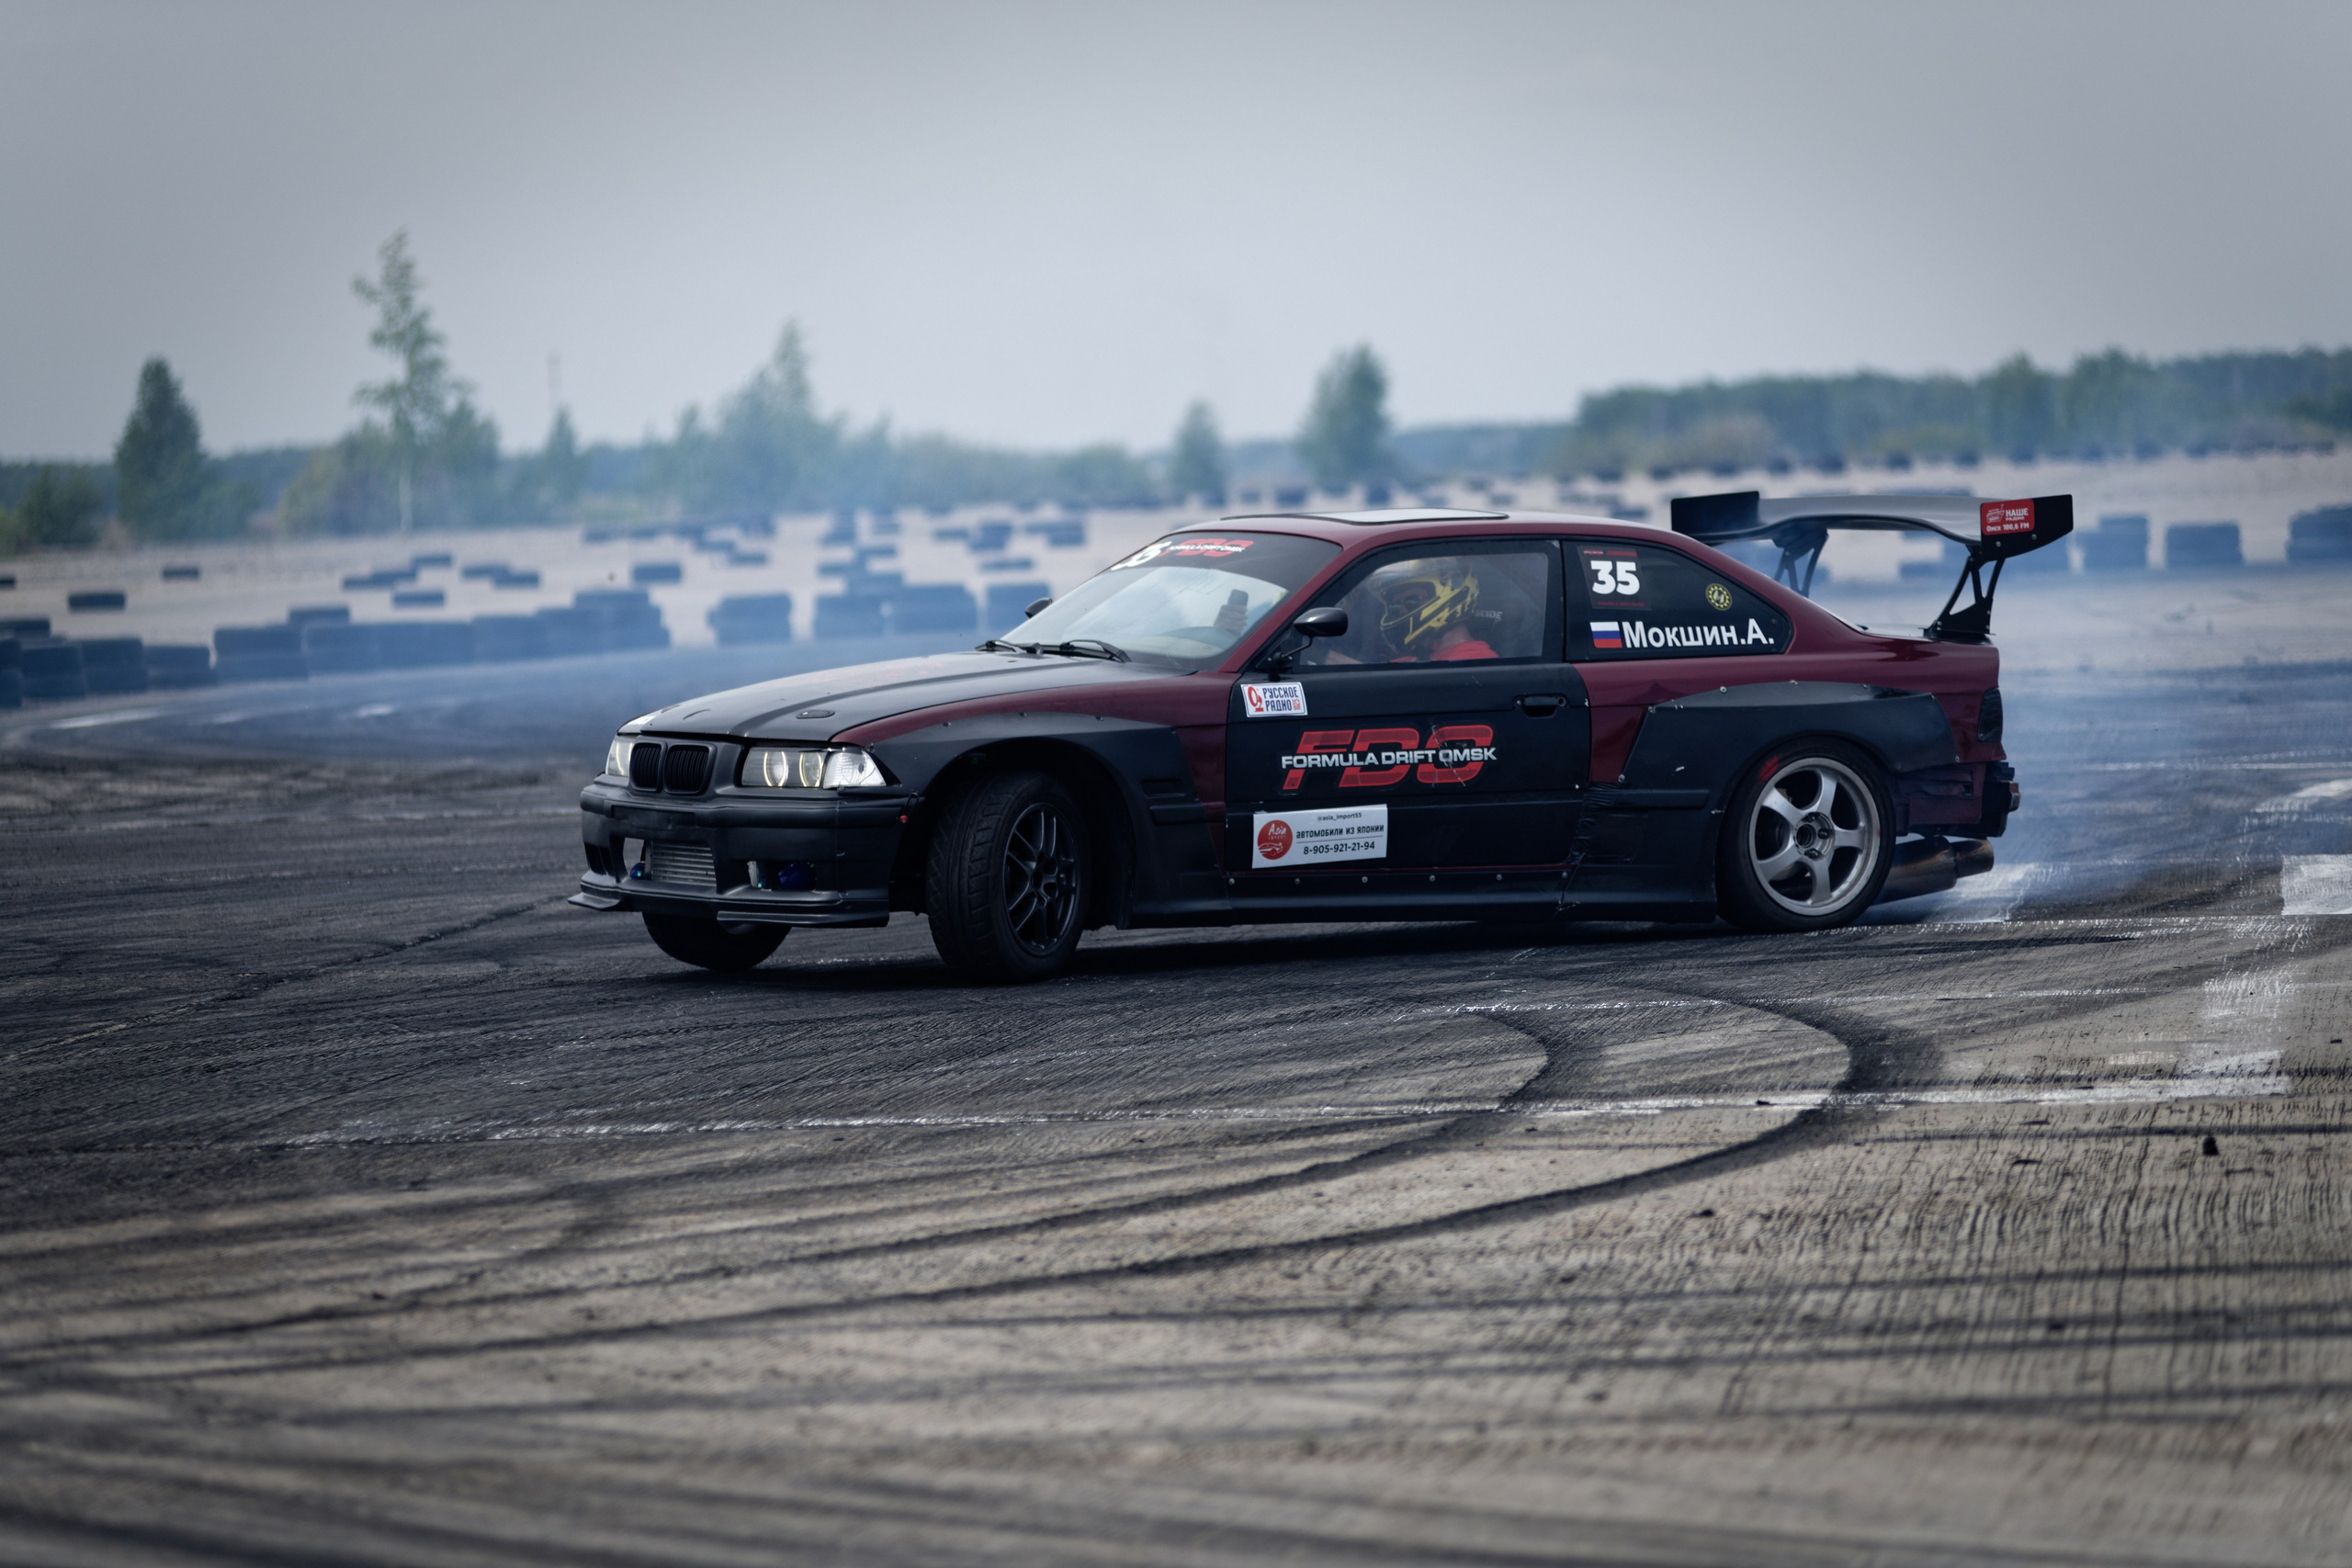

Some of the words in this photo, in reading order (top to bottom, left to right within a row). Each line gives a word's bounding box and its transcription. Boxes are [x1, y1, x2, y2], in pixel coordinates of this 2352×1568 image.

[1590, 560, 1640, 595] 35
[1262, 687, 1299, 699] РУССКОЕ
[1282, 752, 1379, 770] FORMULA
[1381, 750, 1436, 764] DRIFT
[1439, 748, 1498, 761] OMSK
[1304, 841, 1375, 855] 8-905-921-21-94
